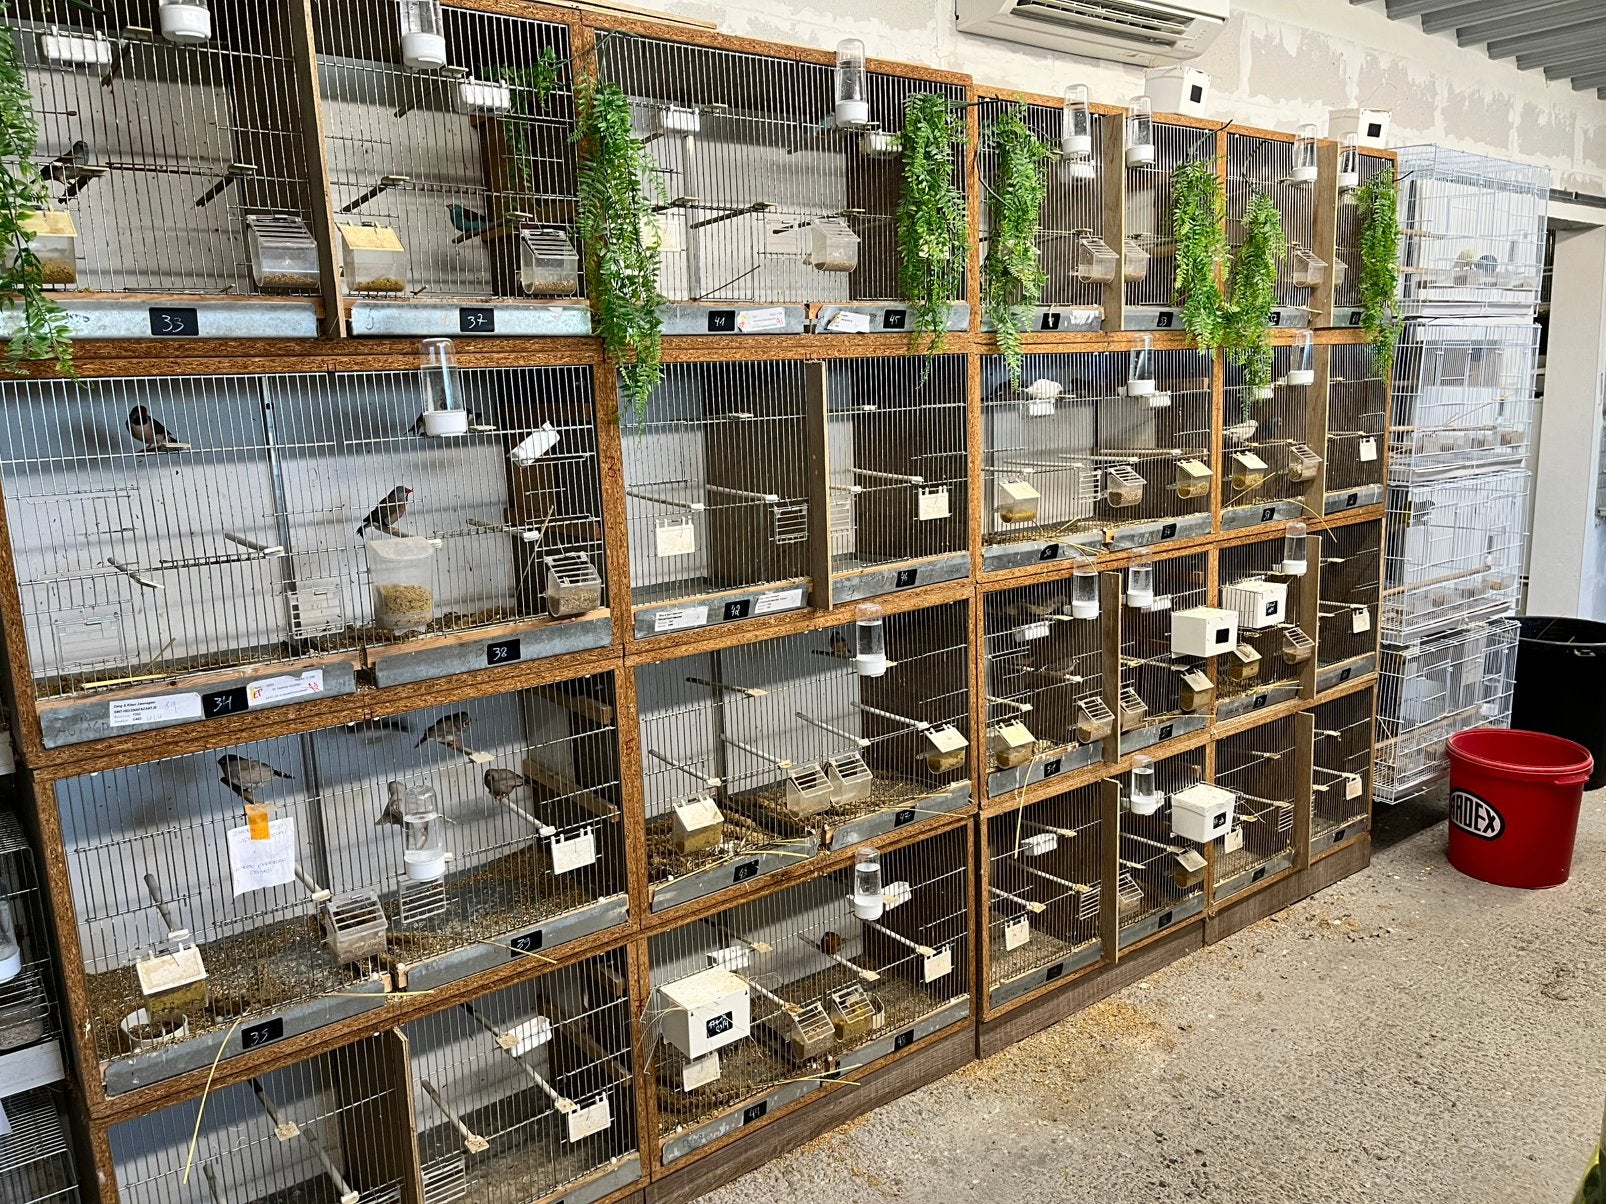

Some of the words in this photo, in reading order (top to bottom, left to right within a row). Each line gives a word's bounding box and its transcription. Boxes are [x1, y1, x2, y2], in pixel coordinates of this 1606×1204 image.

[161, 314, 185, 333] 33
[467, 313, 488, 329] 37
[889, 313, 901, 325] 45
[492, 646, 508, 661] 38
[213, 695, 232, 713] 34
[1450, 793, 1497, 834] ARDEX
[250, 1028, 268, 1046] 35
